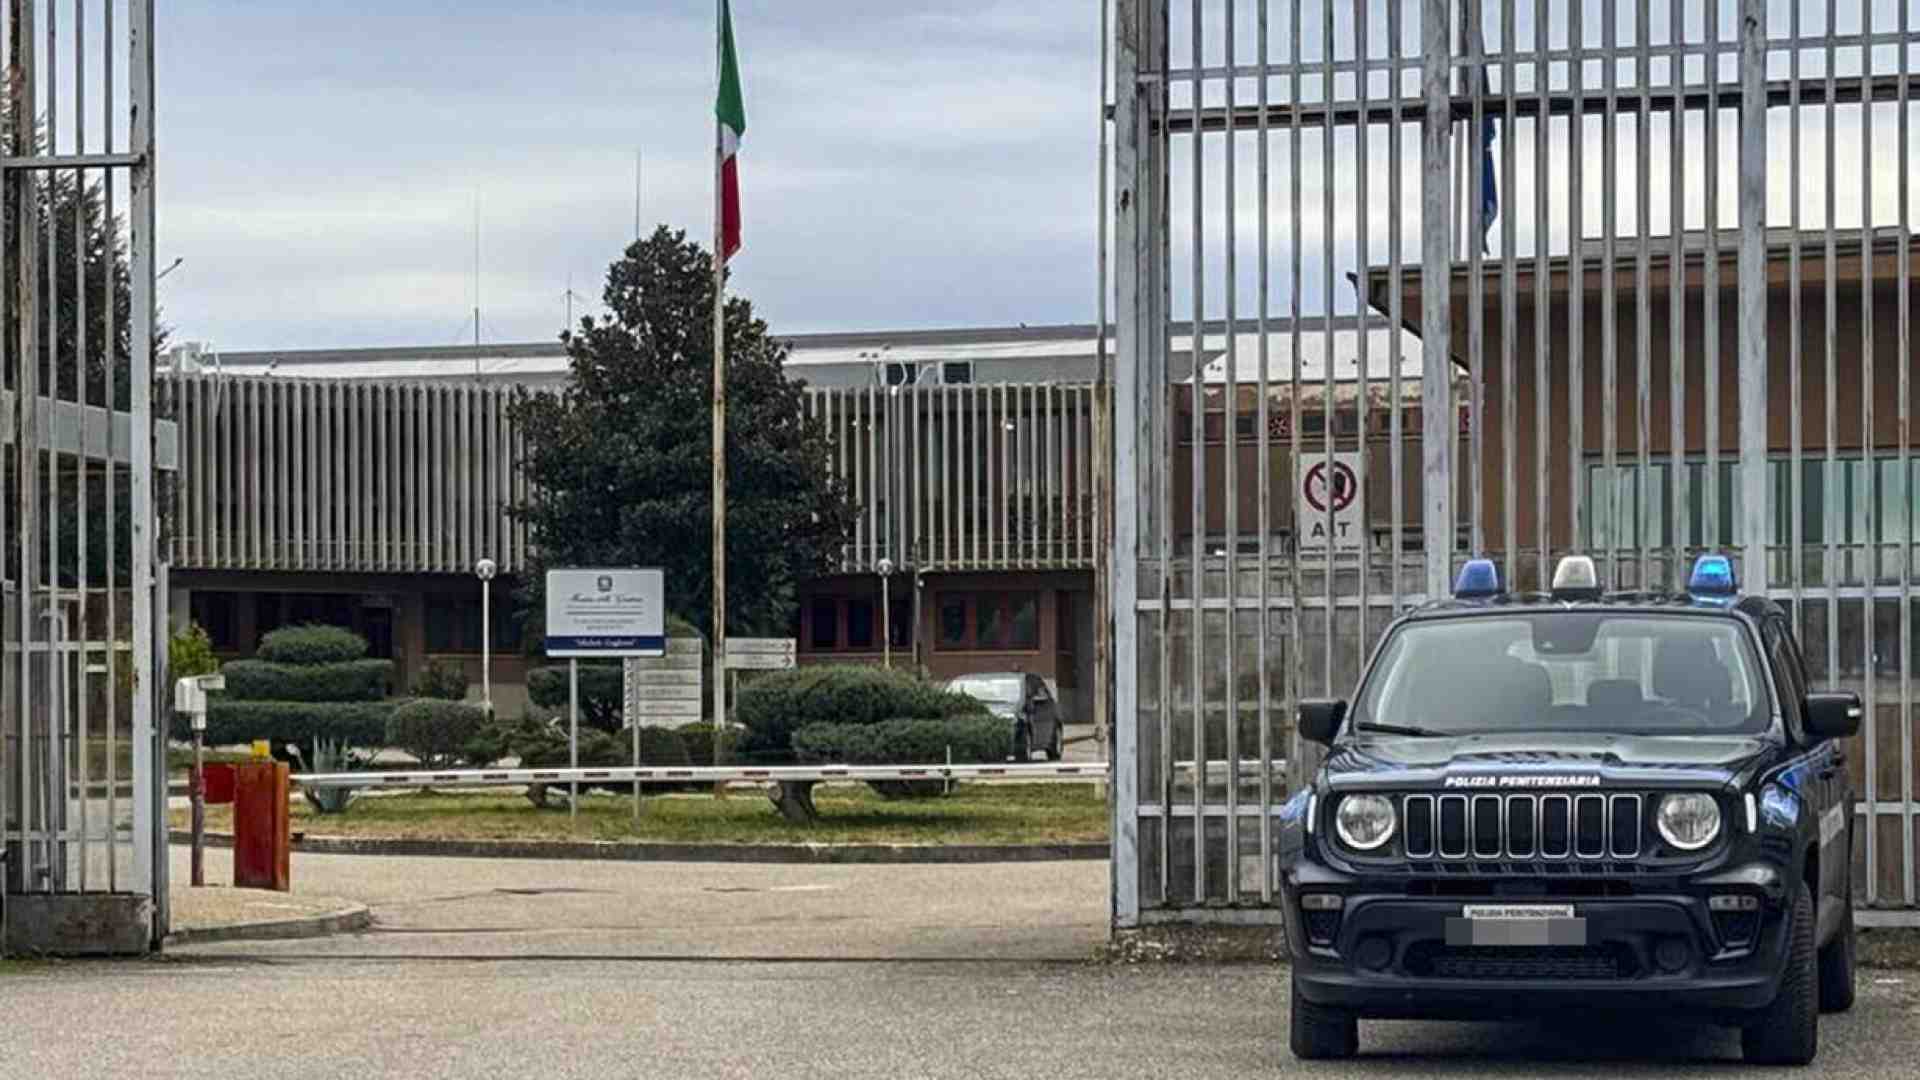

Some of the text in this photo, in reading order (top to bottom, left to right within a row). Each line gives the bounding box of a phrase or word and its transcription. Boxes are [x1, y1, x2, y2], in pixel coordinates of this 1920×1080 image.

[1311, 521, 1351, 537] AT
[1445, 776, 1600, 786] POLIZIA PENITENZIARIA
